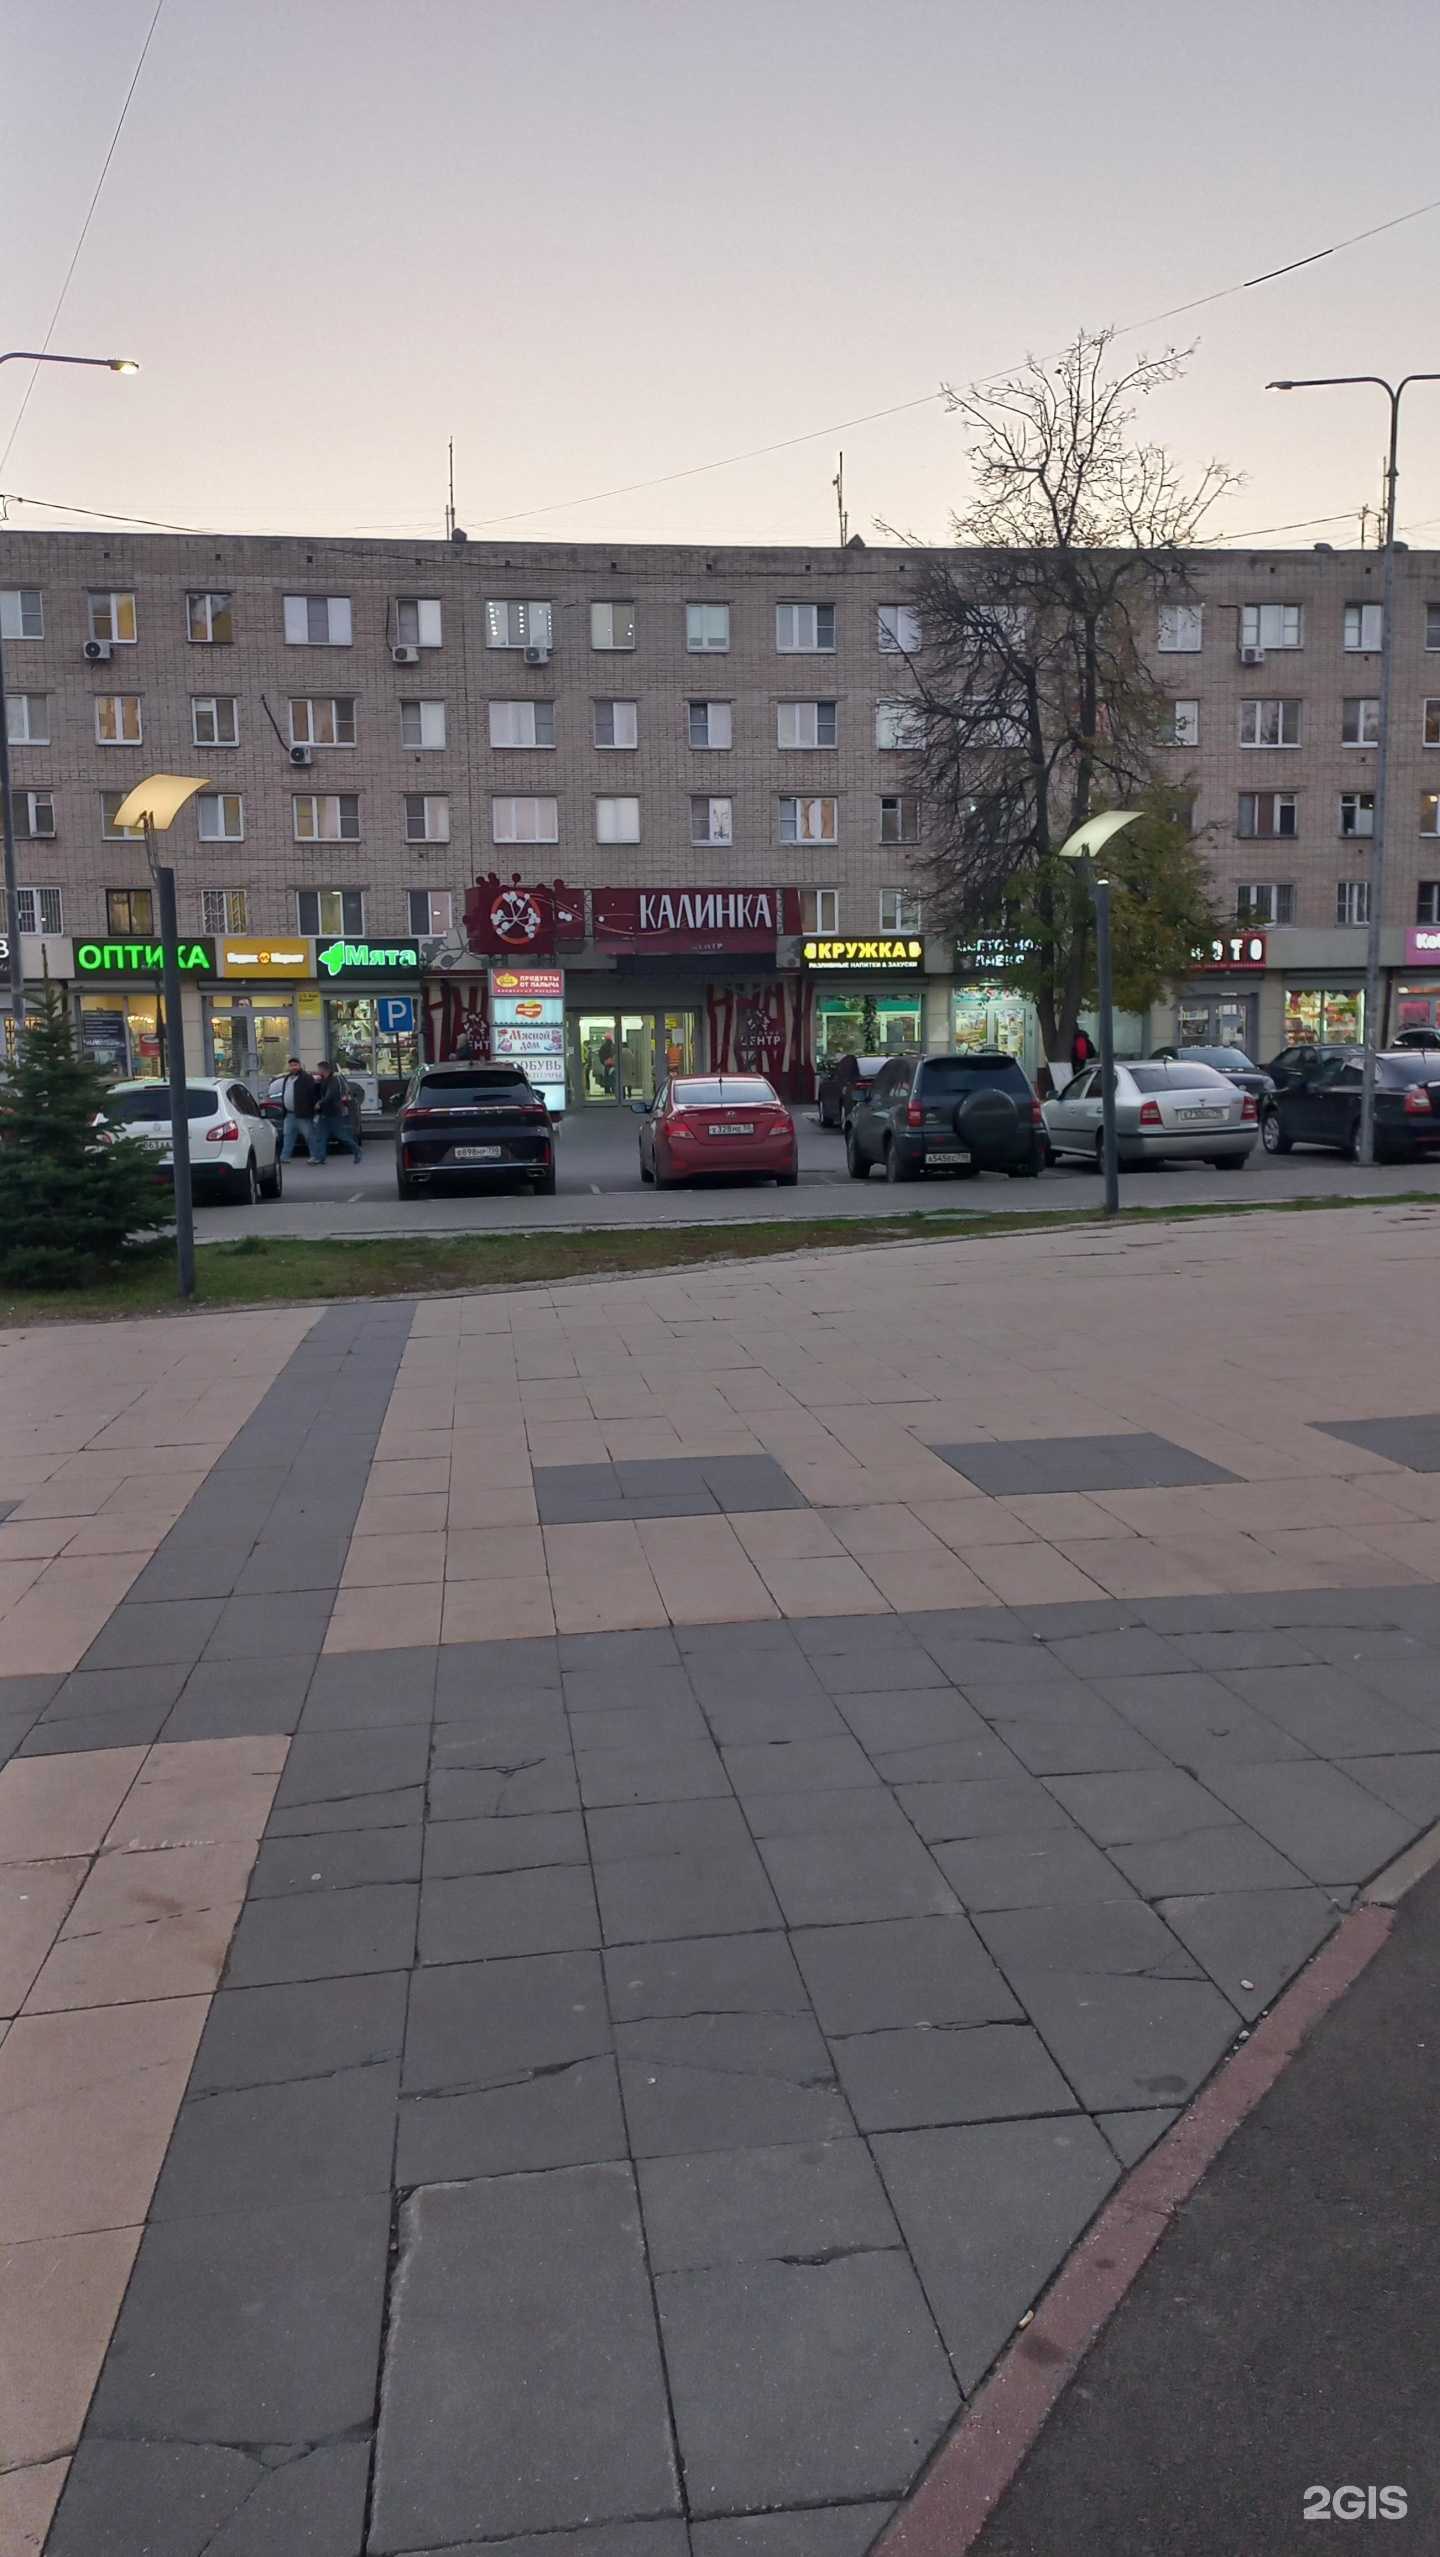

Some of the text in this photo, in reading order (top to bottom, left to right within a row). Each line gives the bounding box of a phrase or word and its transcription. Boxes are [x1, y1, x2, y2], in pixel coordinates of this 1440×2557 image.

[639, 894, 773, 929] КАЛИНКА
[345, 944, 417, 967] Мята
[818, 941, 907, 959] КРУЖКА
